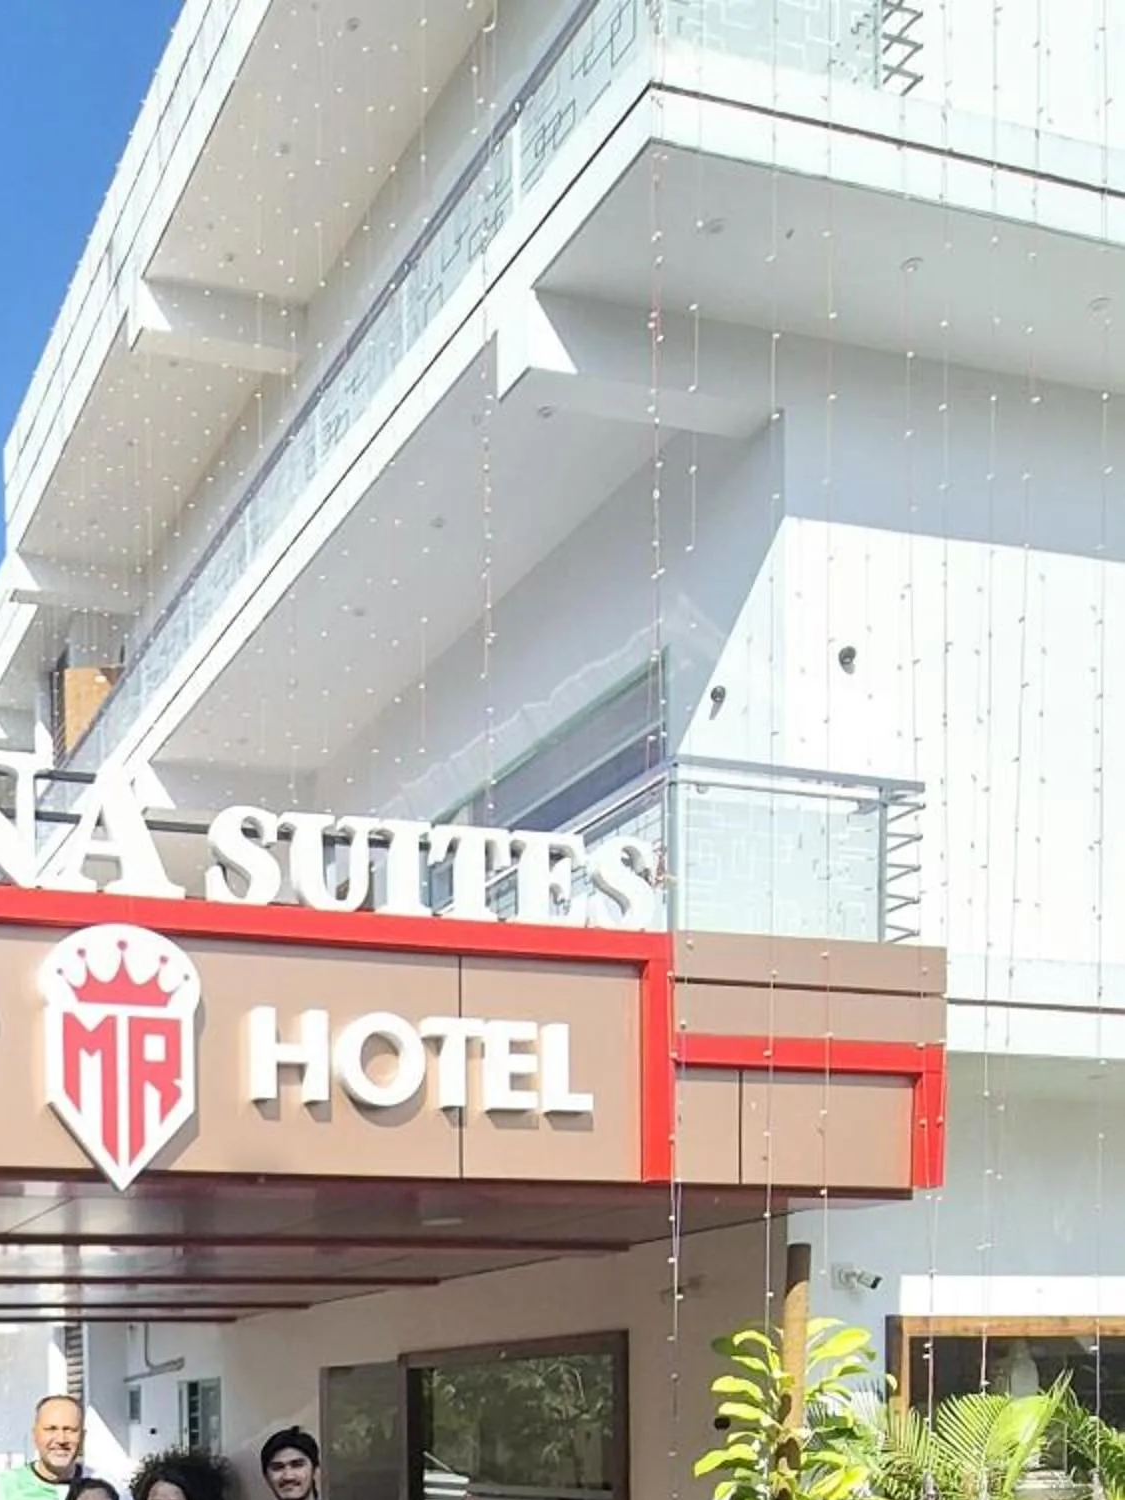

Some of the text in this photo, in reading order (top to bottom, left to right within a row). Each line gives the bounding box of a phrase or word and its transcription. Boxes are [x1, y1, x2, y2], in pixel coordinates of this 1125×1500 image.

[206, 805, 659, 932] SUITES
[62, 1011, 182, 1167] MR
[248, 1005, 594, 1113] HOTEL
